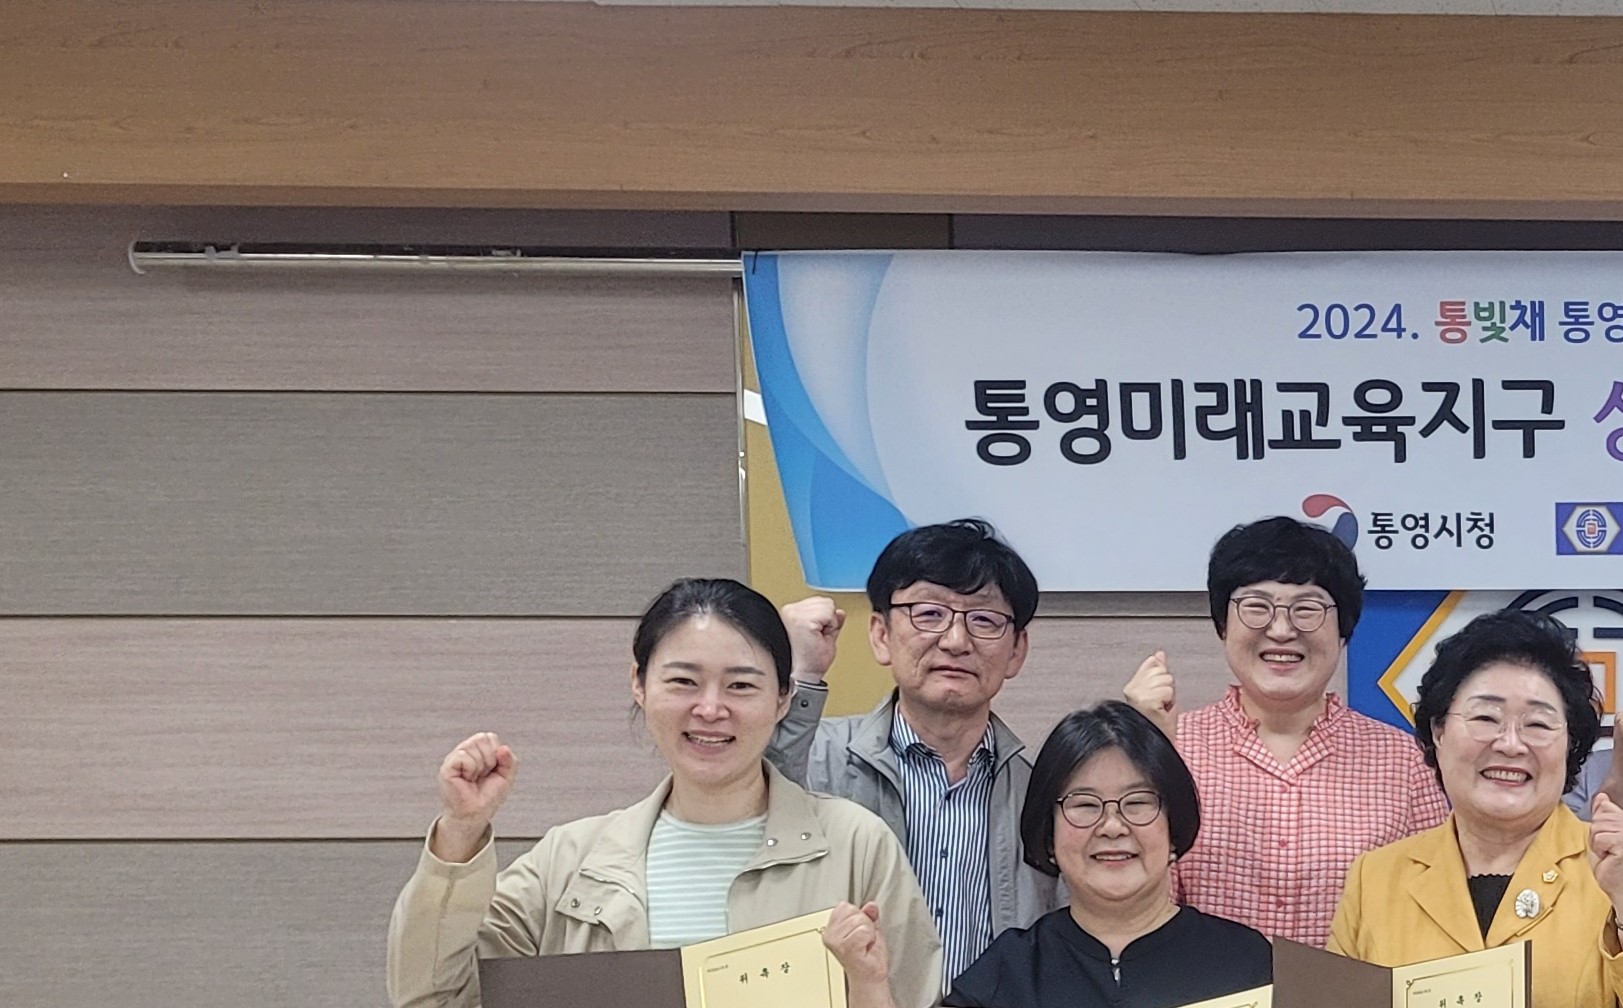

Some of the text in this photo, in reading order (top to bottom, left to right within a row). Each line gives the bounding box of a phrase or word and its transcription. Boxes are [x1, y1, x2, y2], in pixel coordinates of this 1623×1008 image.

[1297, 303, 1419, 340] 2024.
[1435, 300, 1546, 344] 통빛채
[965, 378, 1565, 466] 통영미래교육지구
[1367, 512, 1494, 550] 통영시청
